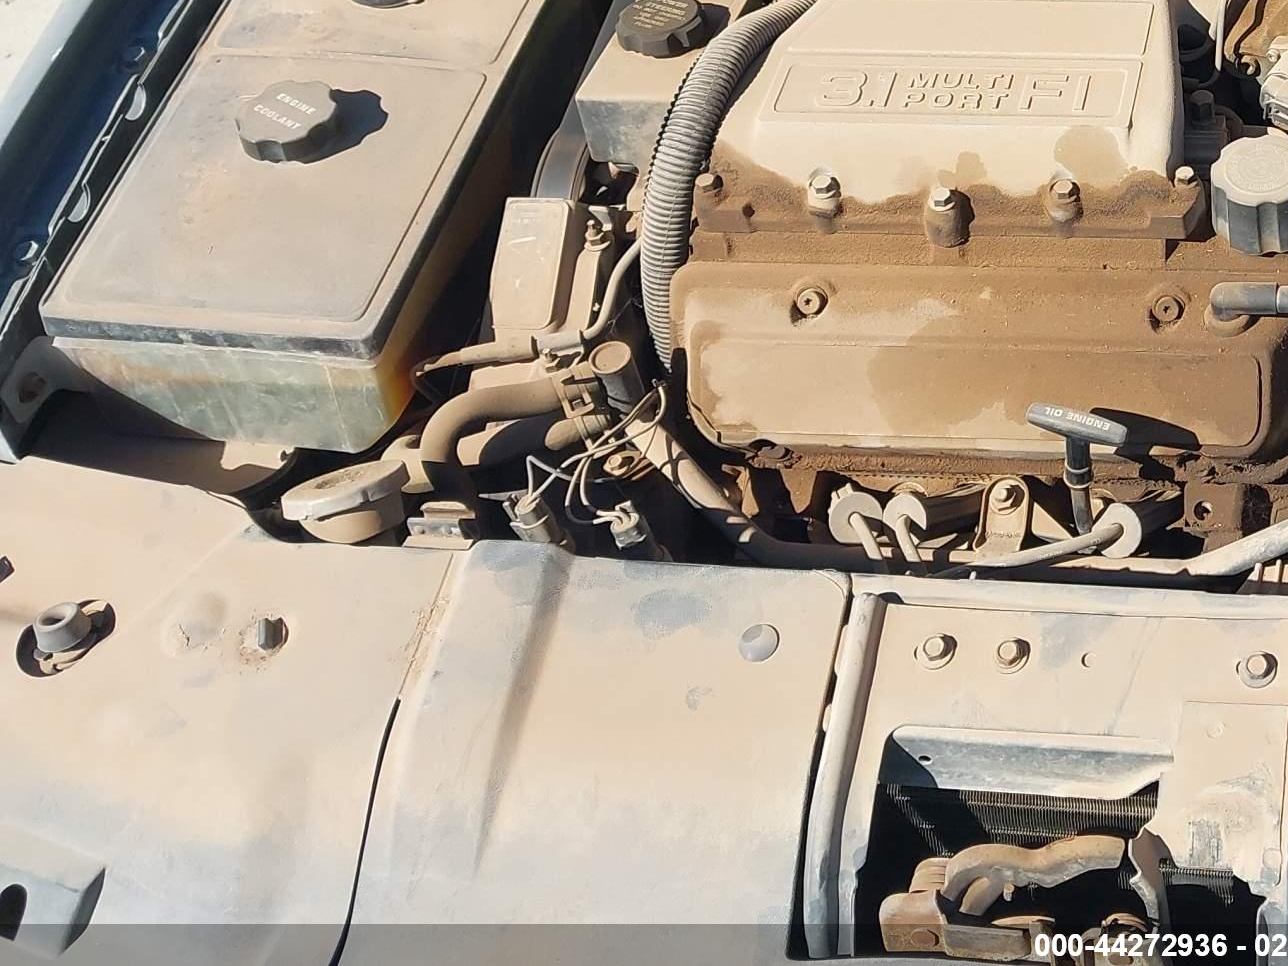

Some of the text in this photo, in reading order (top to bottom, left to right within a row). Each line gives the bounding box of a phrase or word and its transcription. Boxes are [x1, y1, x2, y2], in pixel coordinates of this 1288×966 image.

[645, 2, 686, 16] STEERING
[815, 71, 898, 108] 3.1
[905, 72, 1016, 90] MULTI
[1016, 74, 1092, 111] FI
[275, 92, 317, 115] ENGINE
[900, 92, 1011, 110] PORT
[253, 104, 302, 130] COOLANT
[1045, 406, 1111, 431] ENGINE OIL
